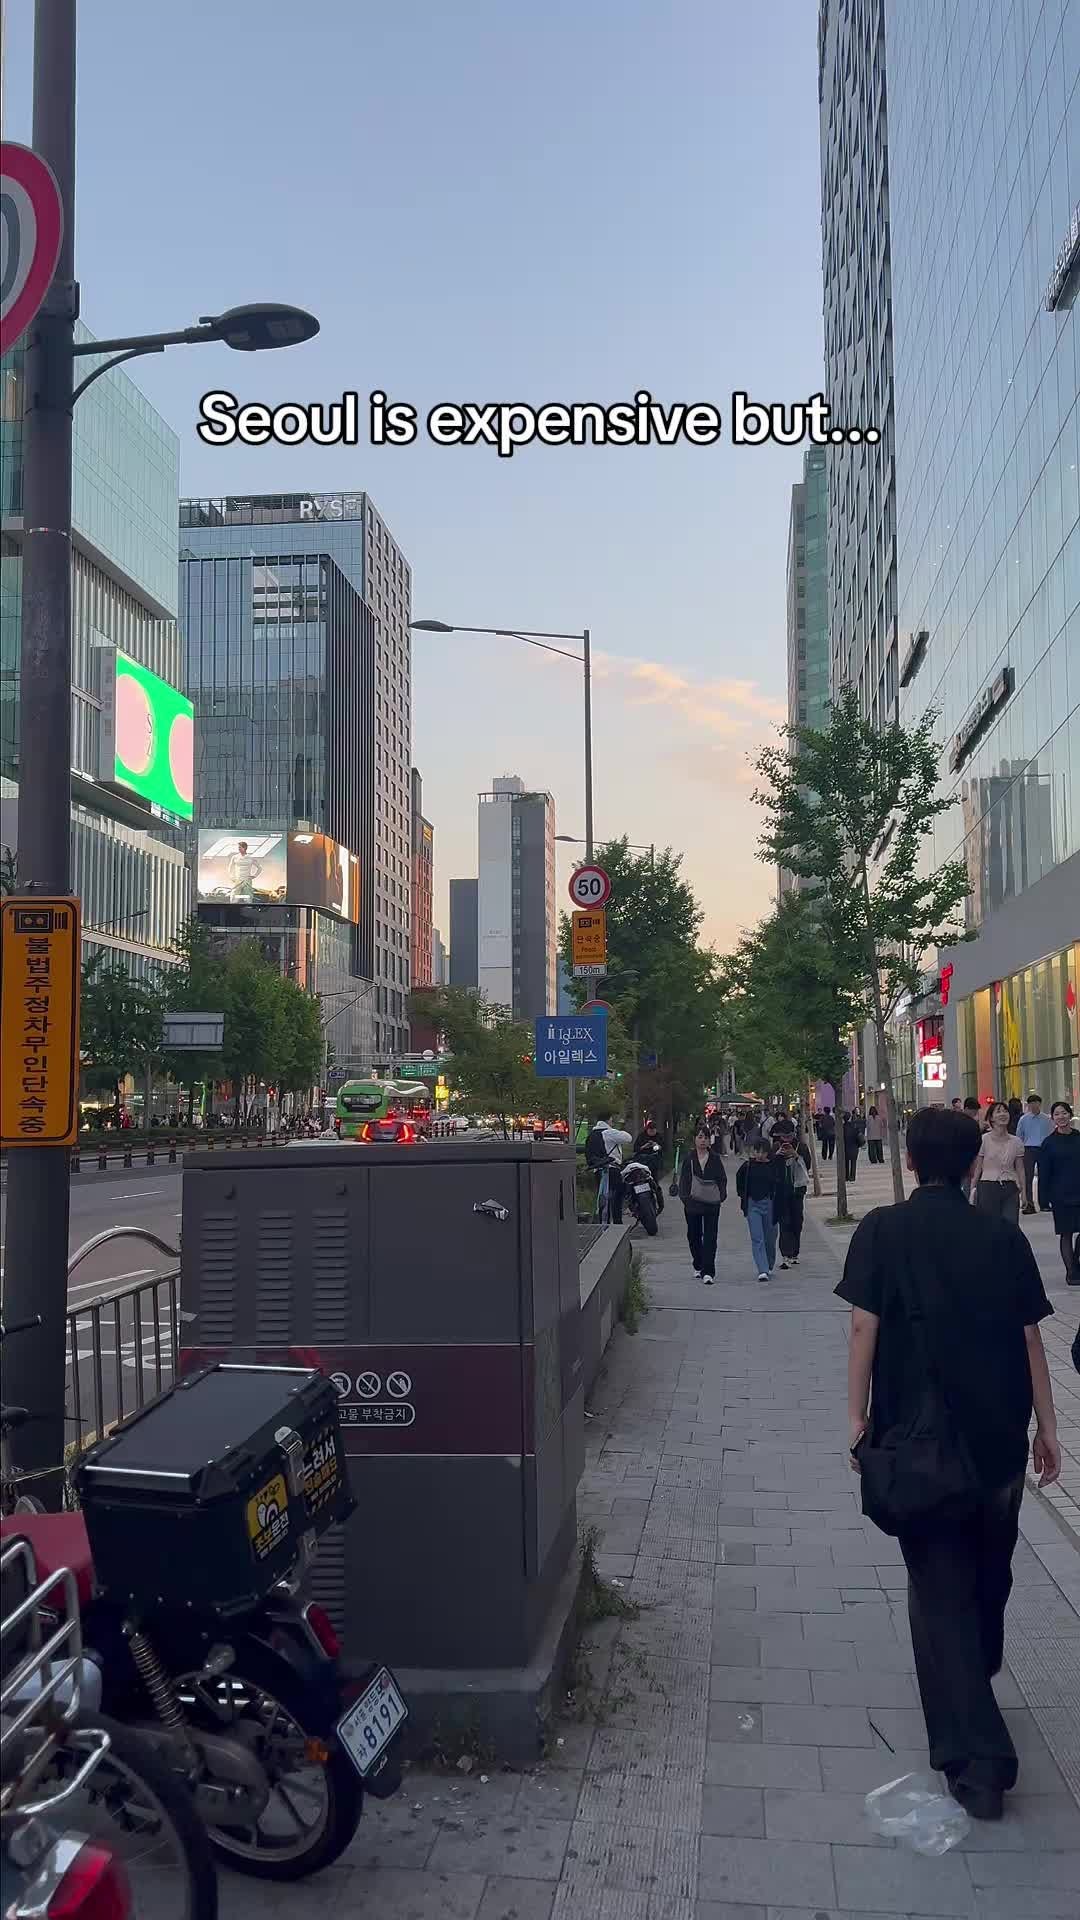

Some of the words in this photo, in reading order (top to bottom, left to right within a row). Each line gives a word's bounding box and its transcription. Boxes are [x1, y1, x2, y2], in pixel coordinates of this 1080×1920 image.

[577, 878, 601, 897] 50
[579, 966, 600, 975] 150m
[18, 937, 52, 1134] 불법주정차무인단속중
[544, 1049, 598, 1065] 아일렉스
[361, 1407, 406, 1421] 부착금지
[363, 1694, 400, 1749] 8191
